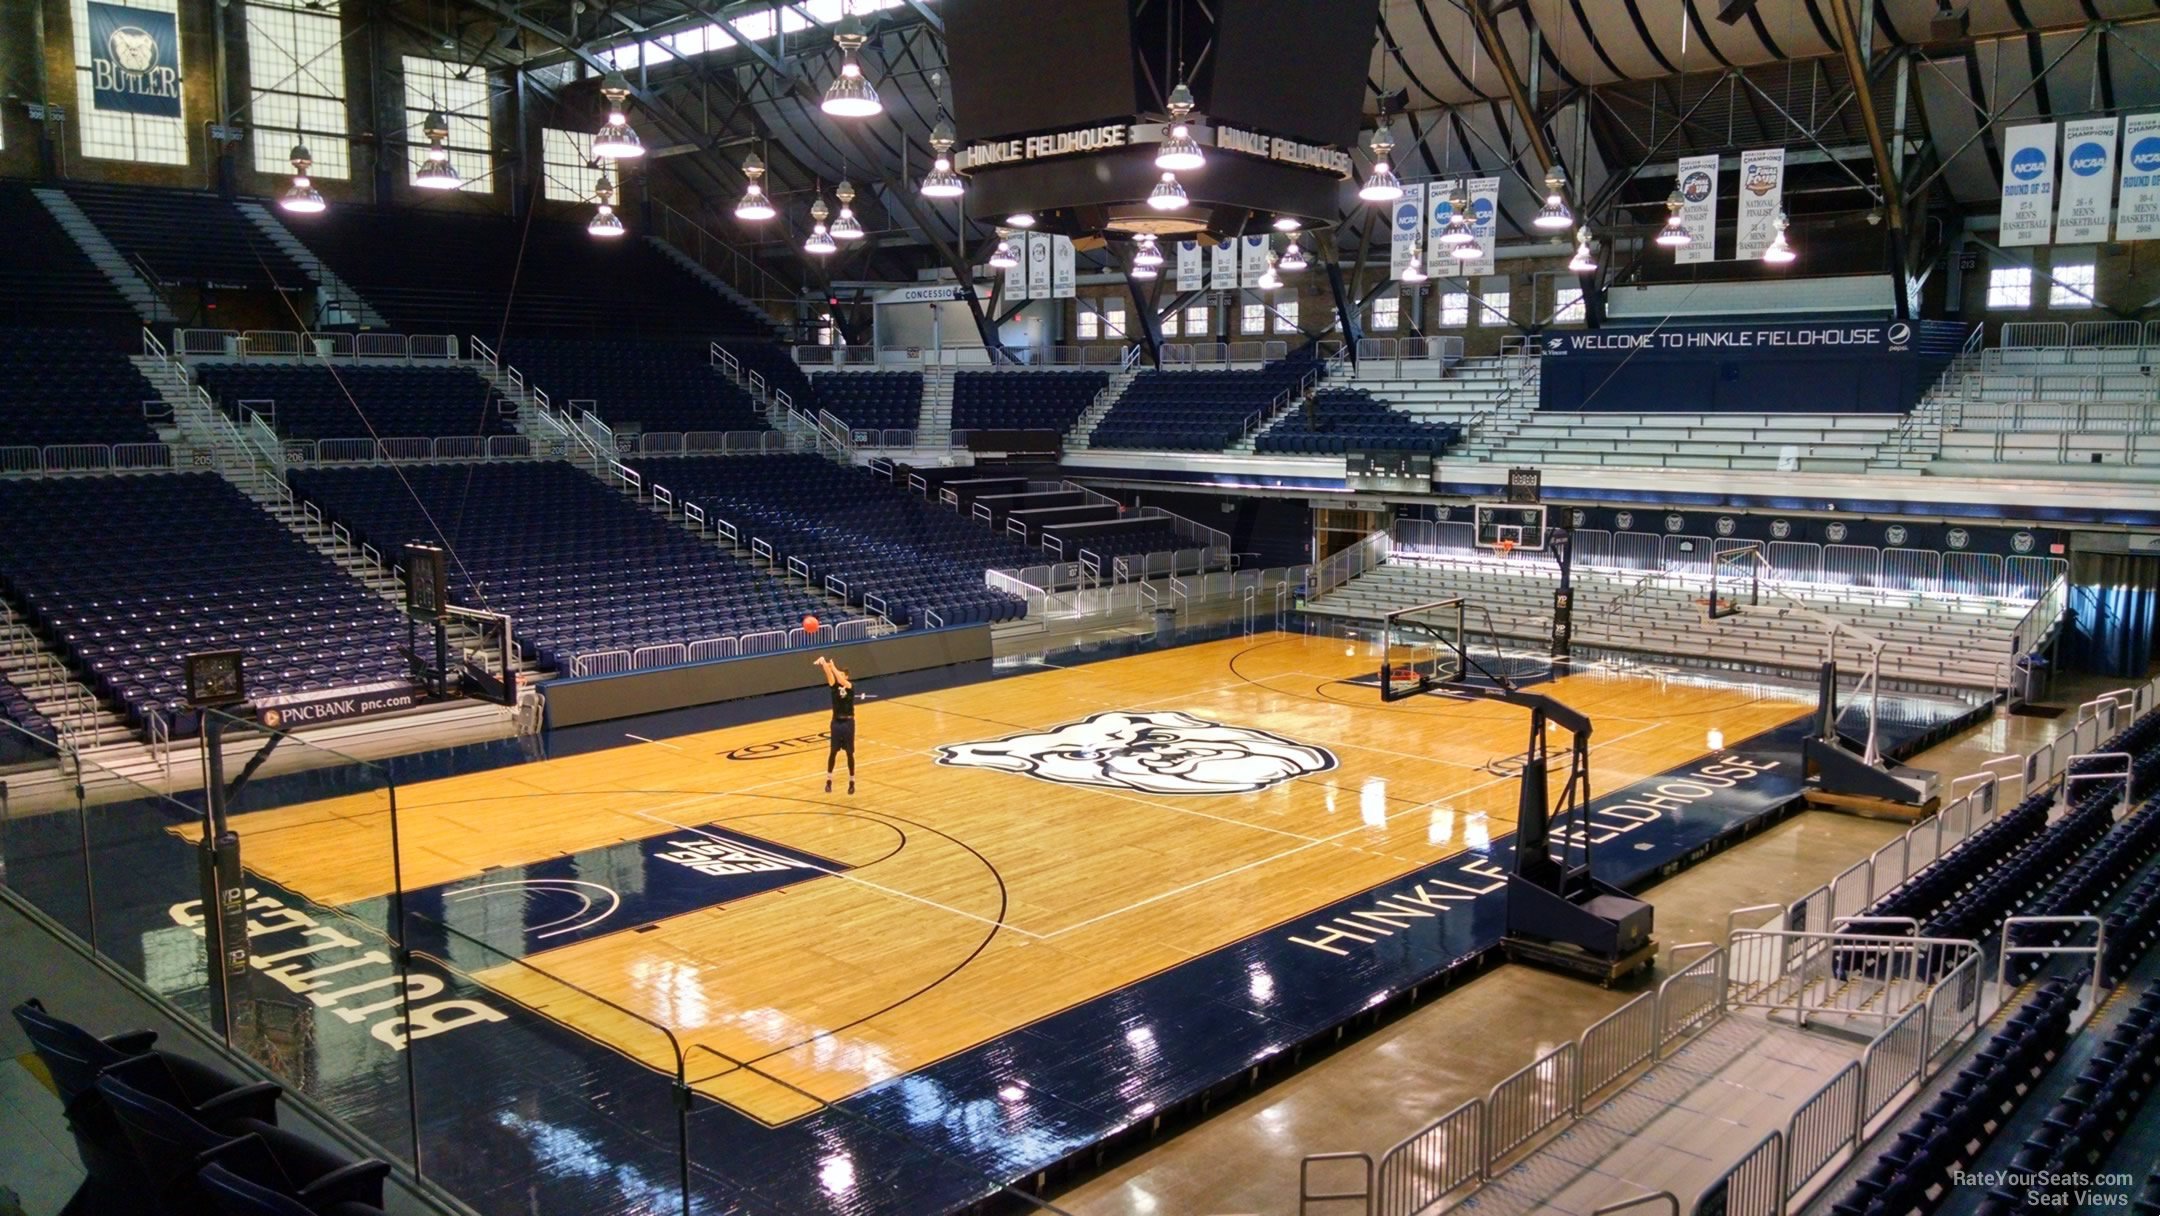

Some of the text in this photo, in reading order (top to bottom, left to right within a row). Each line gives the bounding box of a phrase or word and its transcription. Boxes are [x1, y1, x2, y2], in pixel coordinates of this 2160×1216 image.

[93, 58, 178, 98] BUTLER
[2067, 129, 2115, 139] CHAMPIONS
[967, 124, 1126, 167] HINKLE FIELDHOUSE
[1217, 125, 1349, 172] HINKLE FIELDHOUSE
[1744, 155, 1782, 164] CHAMPIONS
[2073, 157, 2106, 169] NCAA
[1681, 164, 1716, 172] CHAMPIONS
[2014, 162, 2046, 173] NCAA
[2123, 176, 2150, 188] ROUND
[2005, 184, 2029, 196] ROUND
[2030, 183, 2040, 195] OF
[2003, 220, 2048, 231] BASKETBALL
[2060, 216, 2107, 227] BASKETBALL
[1570, 329, 1880, 349] WELCOME TO HINKLE FIELDHOUSE
[194, 455, 213, 465] 205
[287, 452, 304, 463] 206
[361, 695, 411, 713] pnc.com
[1287, 858, 1509, 956] HINKLE
